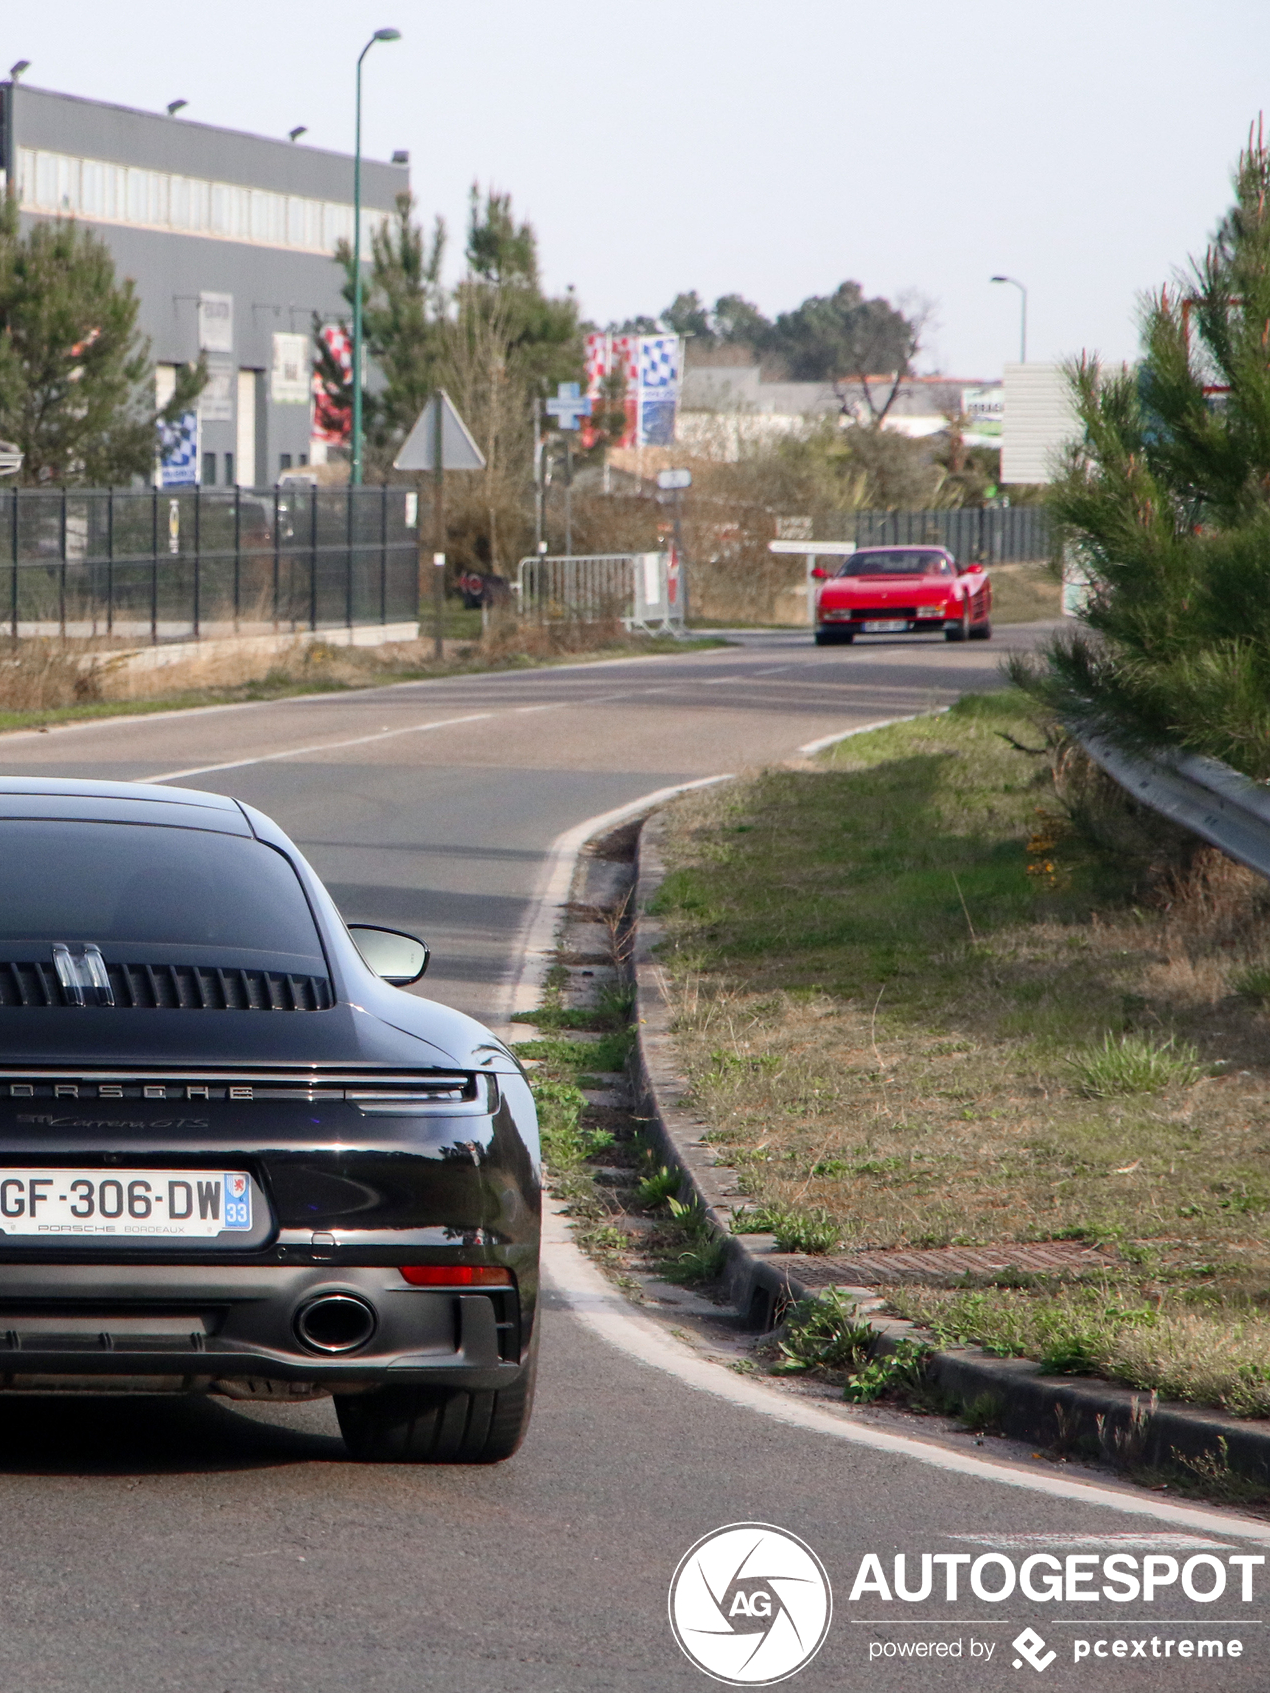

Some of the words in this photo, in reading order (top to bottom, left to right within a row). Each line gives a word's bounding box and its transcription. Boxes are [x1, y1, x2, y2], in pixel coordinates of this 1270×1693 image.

[49, 1115, 144, 1129] Carrera
[150, 1118, 209, 1128] GTS
[0, 1178, 221, 1220] GF-306-DW
[226, 1203, 247, 1223] 33
[38, 1225, 116, 1233] PORSCHE
[124, 1225, 185, 1234] BORDEAUX
